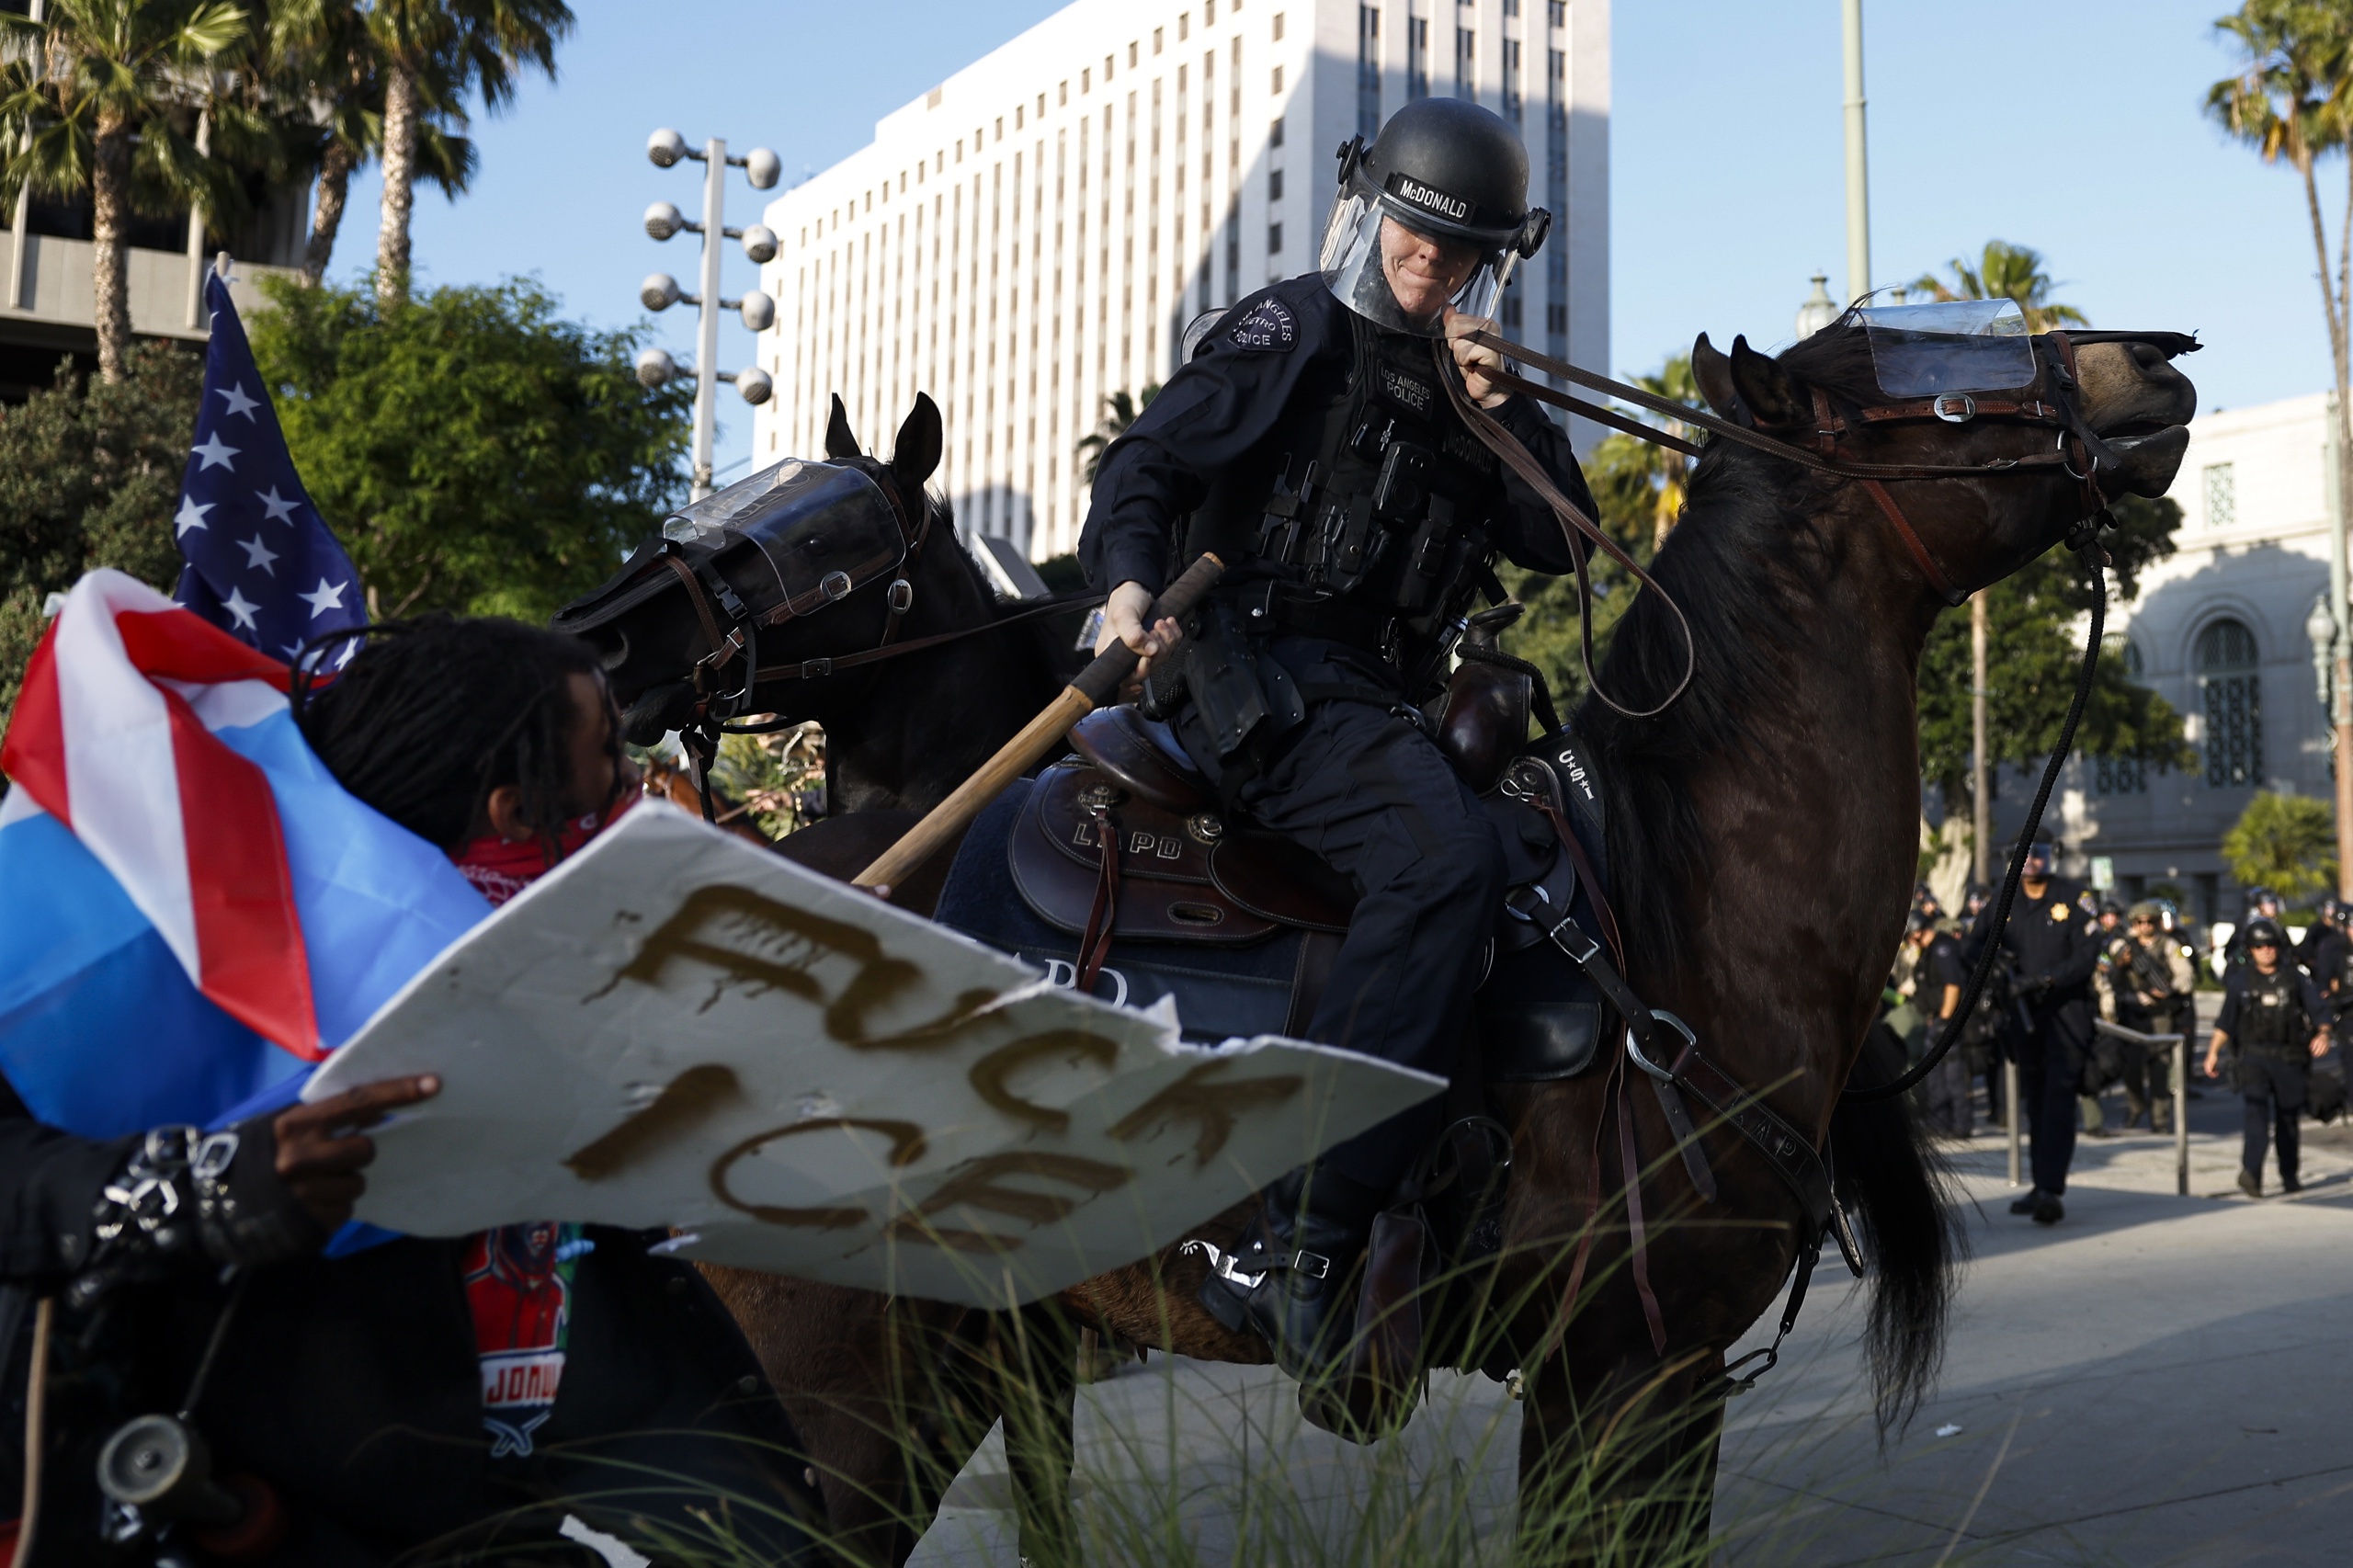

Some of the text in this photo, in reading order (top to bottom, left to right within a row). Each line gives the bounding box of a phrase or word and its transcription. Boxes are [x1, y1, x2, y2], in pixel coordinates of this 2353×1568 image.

[1399, 179, 1468, 220] McDONALD
[1234, 330, 1271, 346] POLICE
[1255, 299, 1293, 342] ANGELES
[1381, 367, 1431, 400] LOS ANGELES
[1386, 381, 1426, 412] POLICE
[617, 882, 1306, 1167] FUCK
[562, 1063, 1132, 1255] ICE
